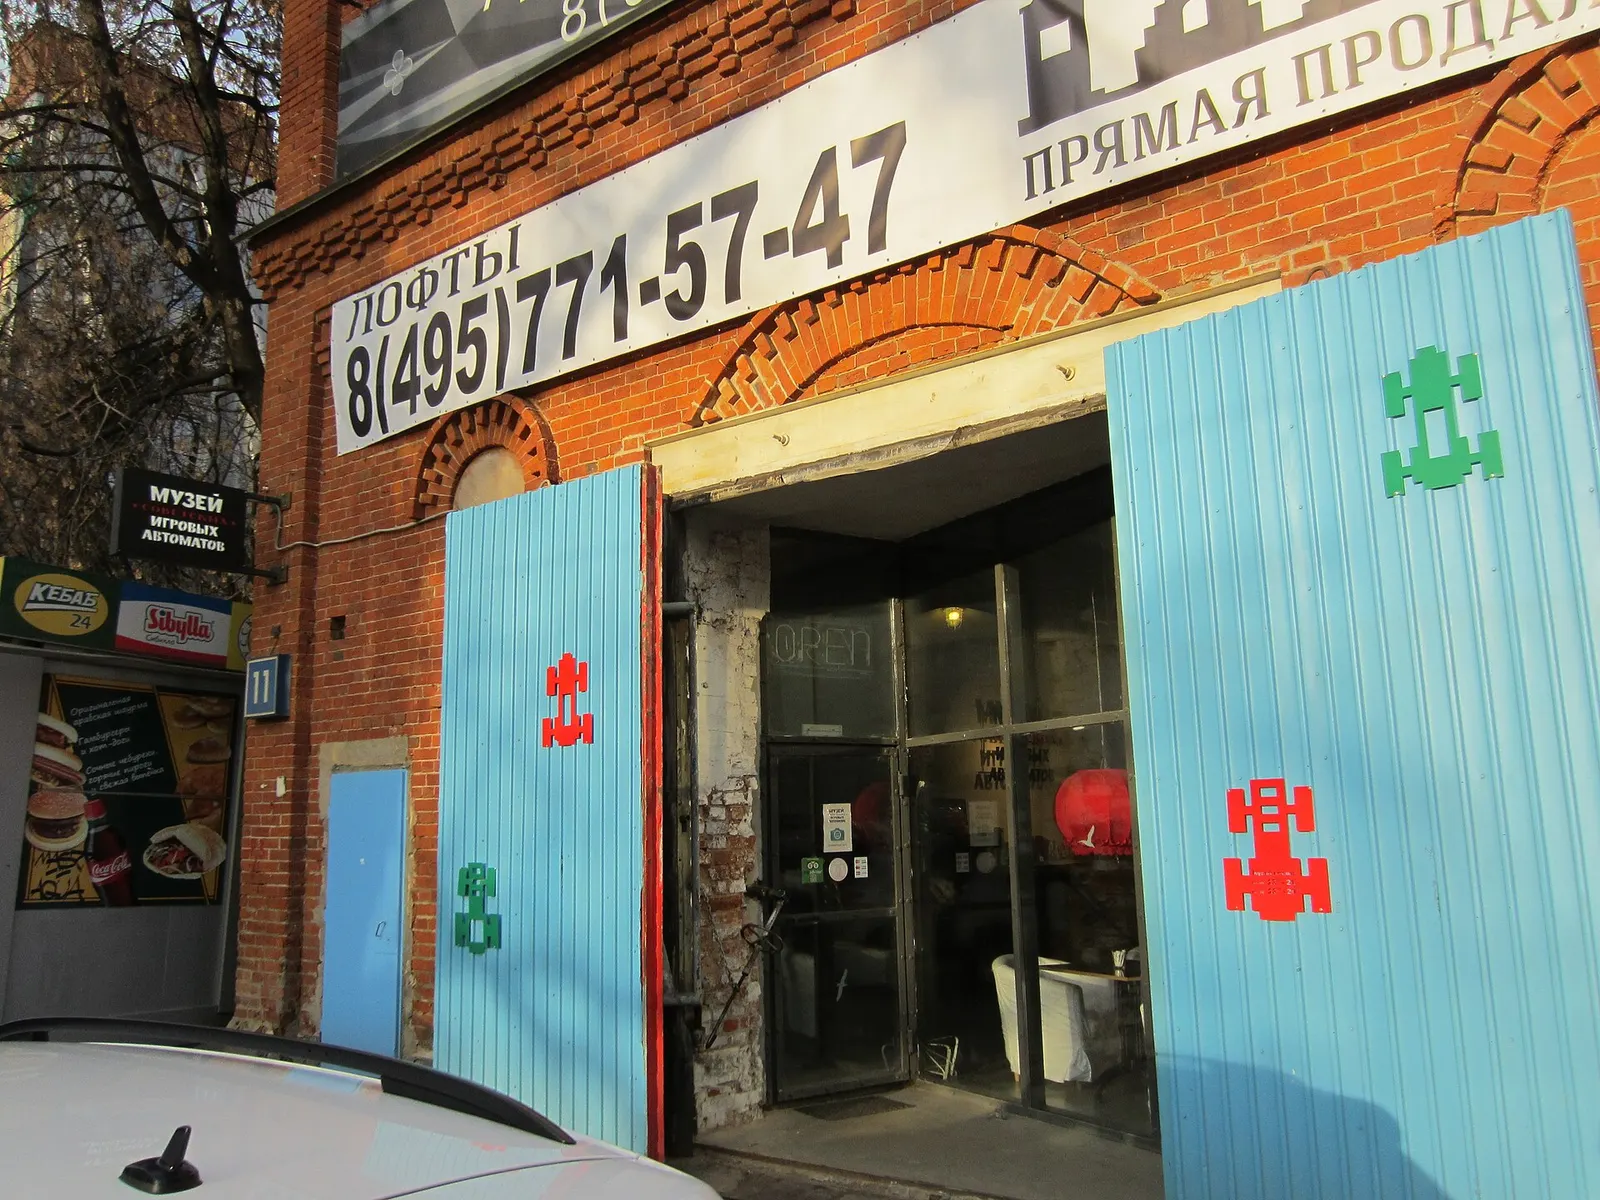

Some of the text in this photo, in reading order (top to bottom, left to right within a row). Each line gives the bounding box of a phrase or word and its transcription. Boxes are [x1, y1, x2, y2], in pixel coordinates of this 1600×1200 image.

[1023, 66, 1272, 201] ПРЯМАЯ
[345, 223, 522, 343] ЛОФТЫ
[347, 120, 907, 438] 8(495)771-57-47
[150, 485, 224, 513] МУЗЕЙ
[141, 528, 226, 552] АВТОМАТОВ
[150, 515, 219, 537] ИГРОВЫХ
[29, 581, 99, 608] КЕБАБ
[69, 613, 91, 630] 24
[147, 606, 212, 641] Sibylla
[253, 669, 270, 705] 11
